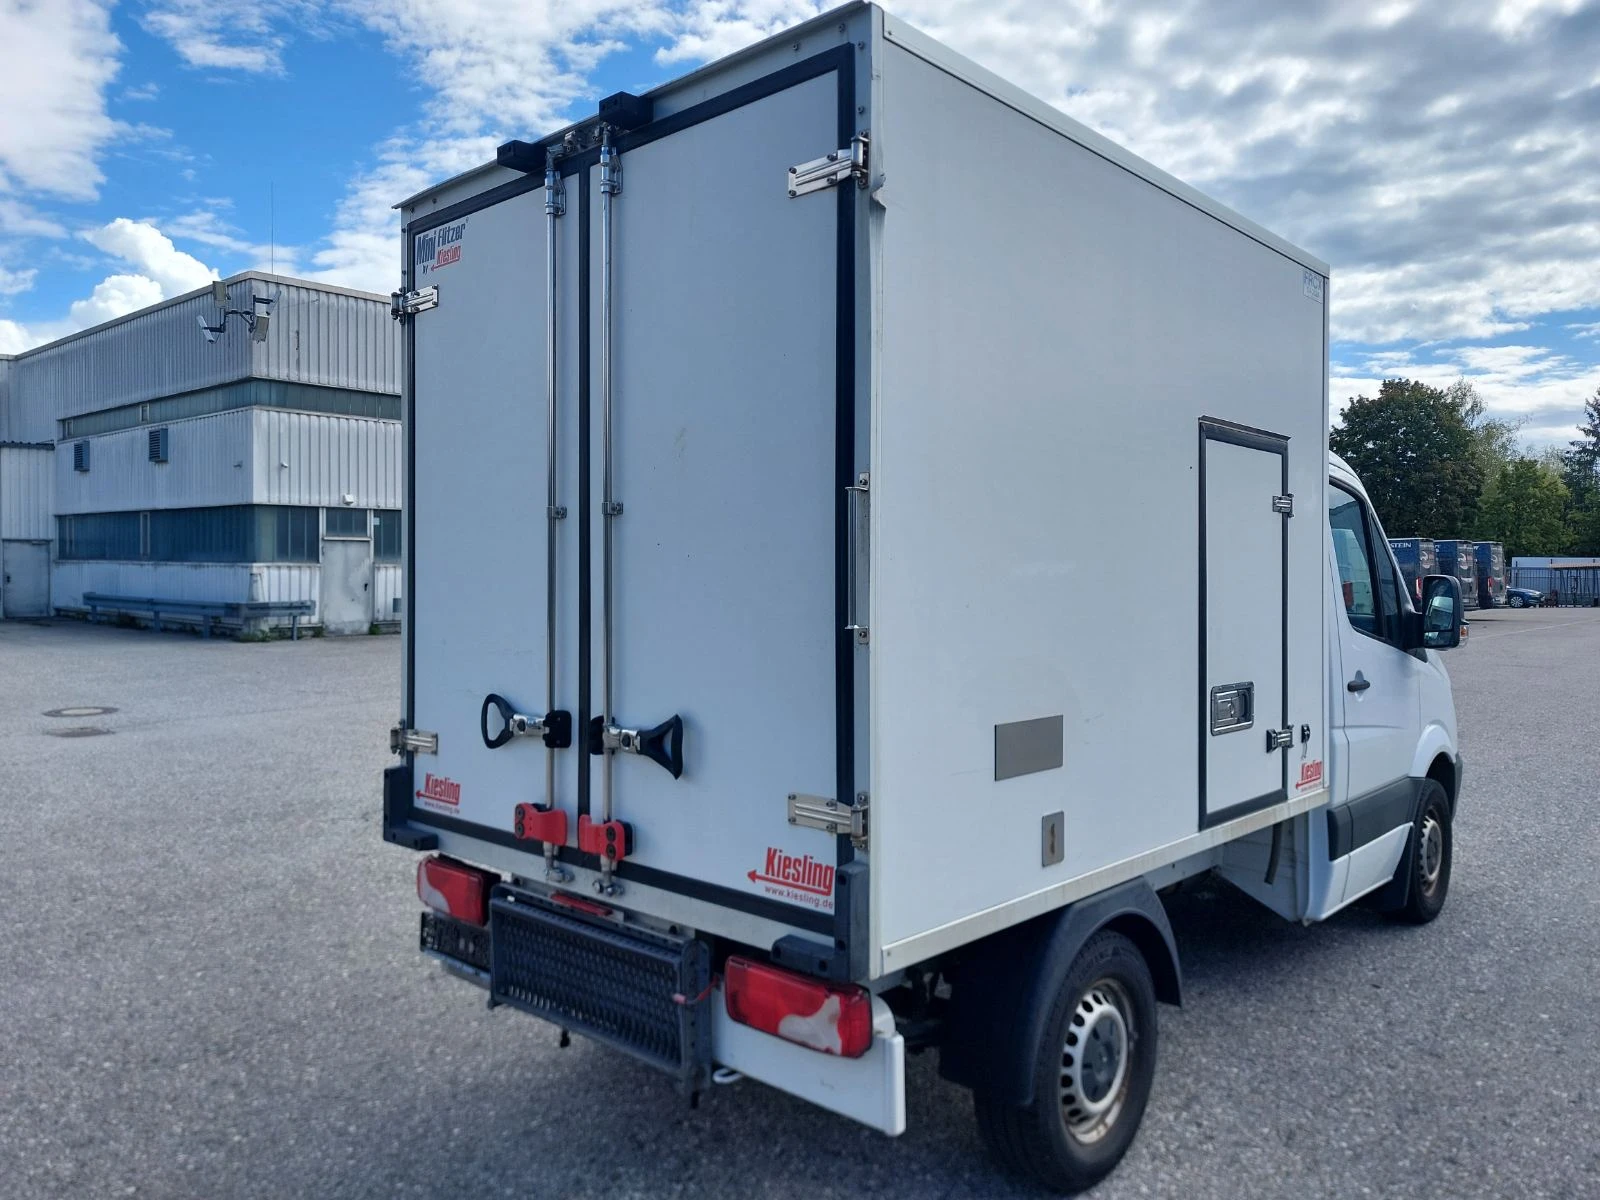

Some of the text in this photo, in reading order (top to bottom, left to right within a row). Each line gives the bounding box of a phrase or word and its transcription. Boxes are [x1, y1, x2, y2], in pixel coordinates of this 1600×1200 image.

[416, 230, 437, 265] Mini
[436, 244, 461, 265] Kiesling
[1301, 759, 1322, 781] Kiesling
[425, 771, 461, 804] Kiesling
[765, 846, 834, 896] Kiesling
[764, 886, 834, 909] www.kiesling.de
